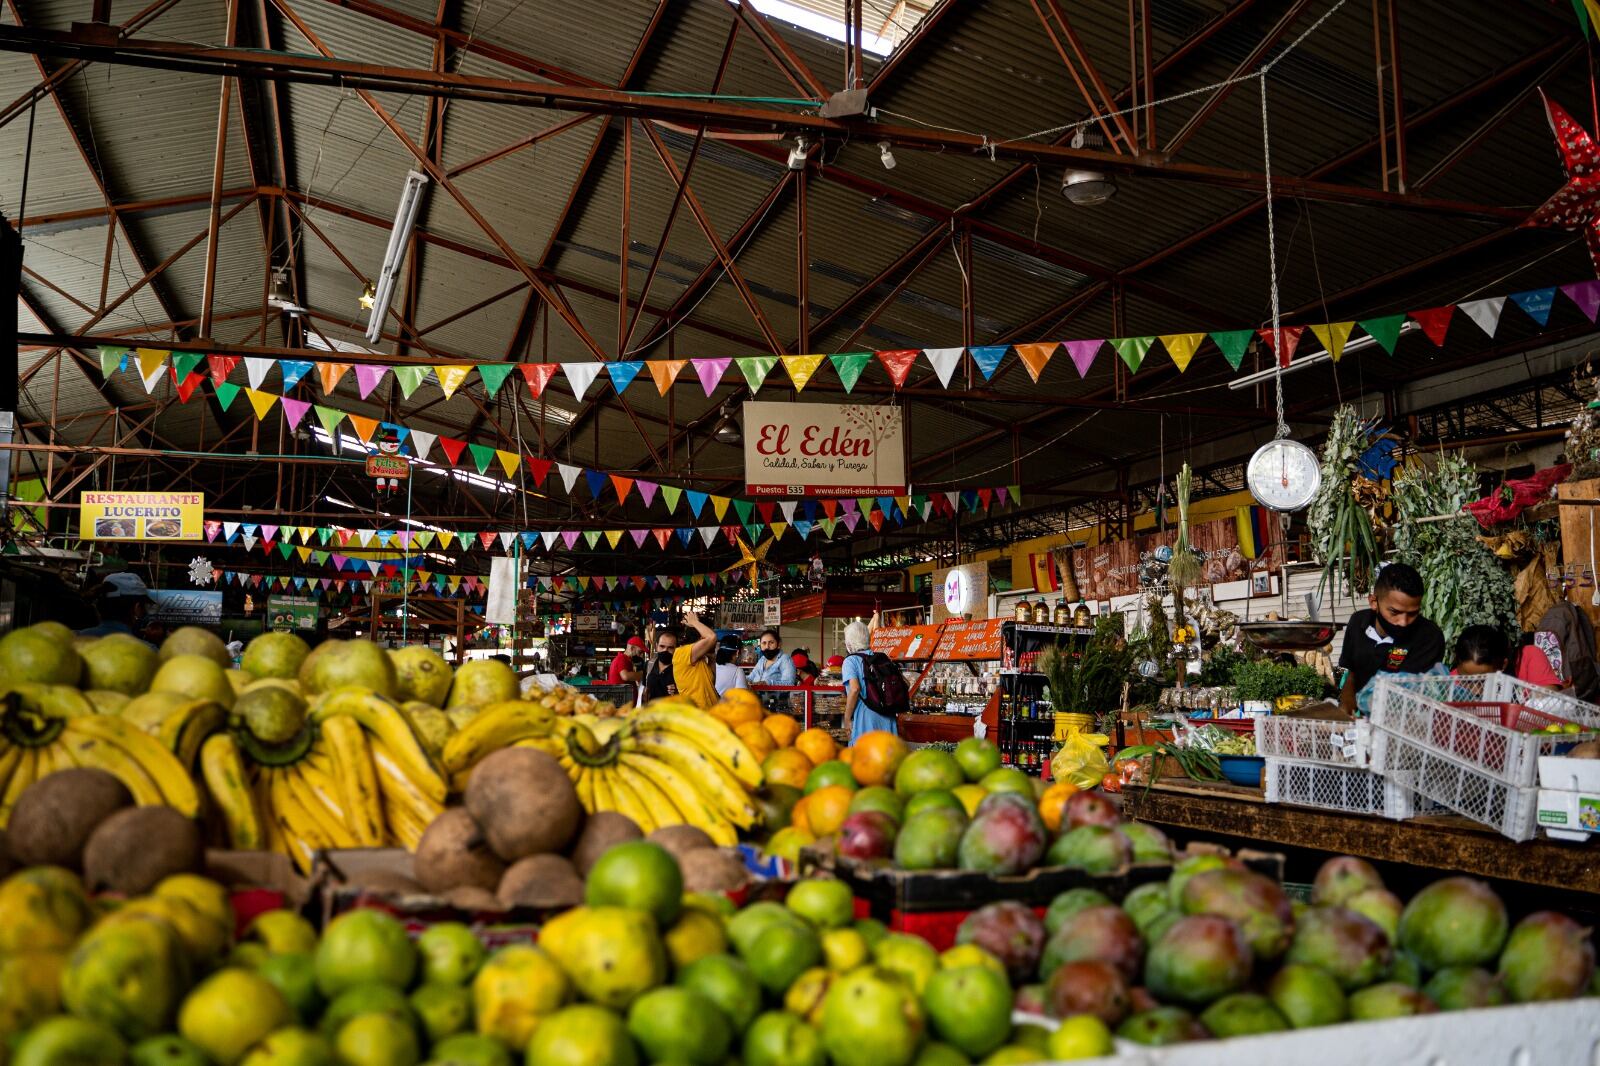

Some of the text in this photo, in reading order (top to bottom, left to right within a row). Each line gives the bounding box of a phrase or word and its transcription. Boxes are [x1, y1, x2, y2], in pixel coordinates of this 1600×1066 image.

[756, 424, 873, 457] El Edén
[763, 457, 868, 472] Calidad, Sabor y Pureza
[756, 486, 895, 495] Puesto: 535 www.distri-eleden.com
[85, 494, 200, 505] RESTAURANTE
[104, 507, 181, 517] LUCERITO
[723, 602, 764, 614] TORTILLERI
[731, 613, 757, 623] DORITA
